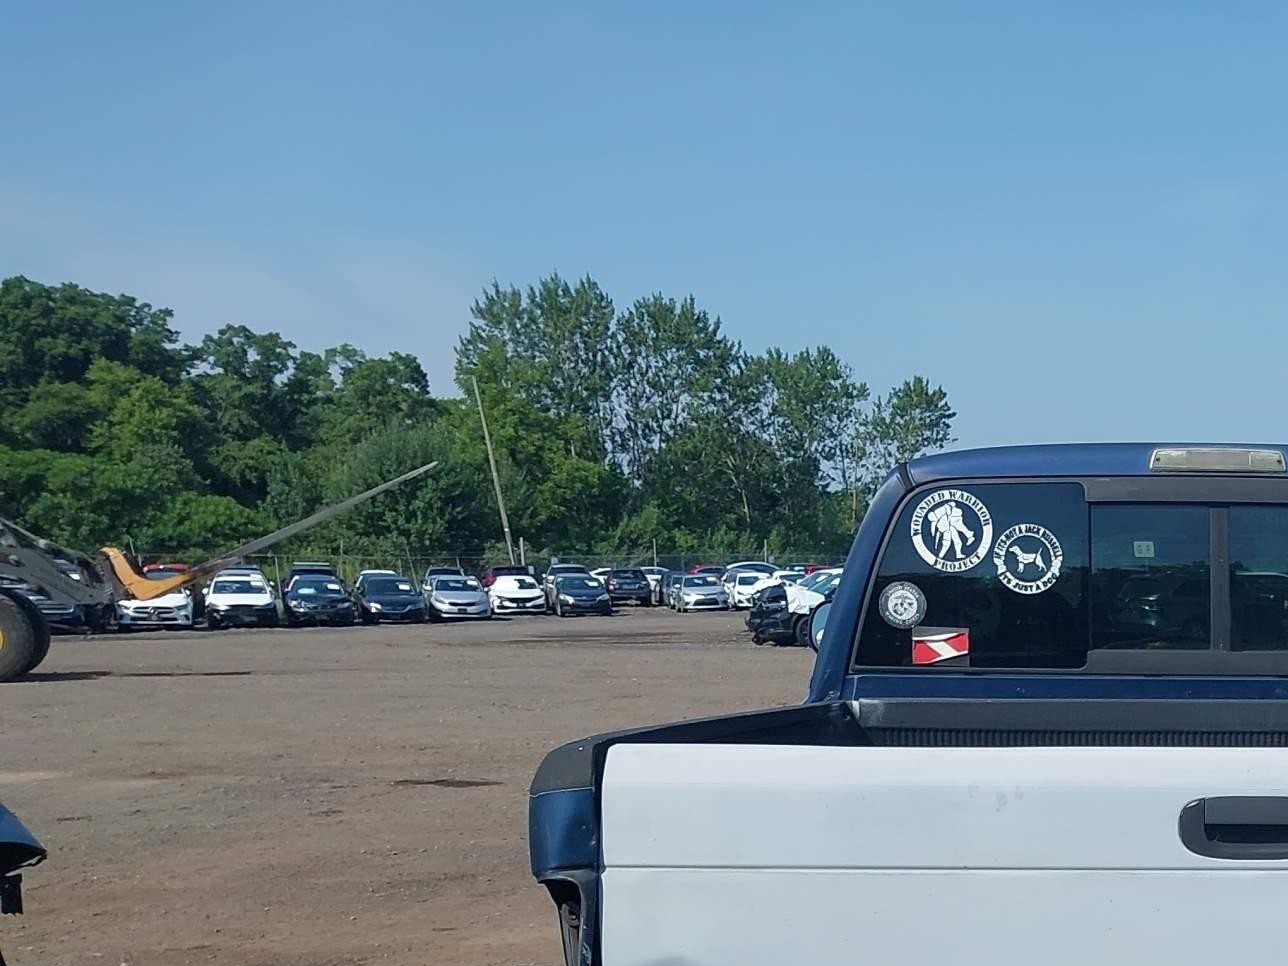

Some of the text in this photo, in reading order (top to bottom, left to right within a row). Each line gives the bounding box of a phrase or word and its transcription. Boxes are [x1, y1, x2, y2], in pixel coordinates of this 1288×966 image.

[912, 490, 991, 536] WOUNDED WARRIOR
[1025, 525, 1041, 536] JACK
[1041, 531, 1063, 559] RUSSELL
[933, 552, 981, 570] PROJECT
[1013, 582, 1034, 592] JUST
[1042, 572, 1058, 587] DOG
